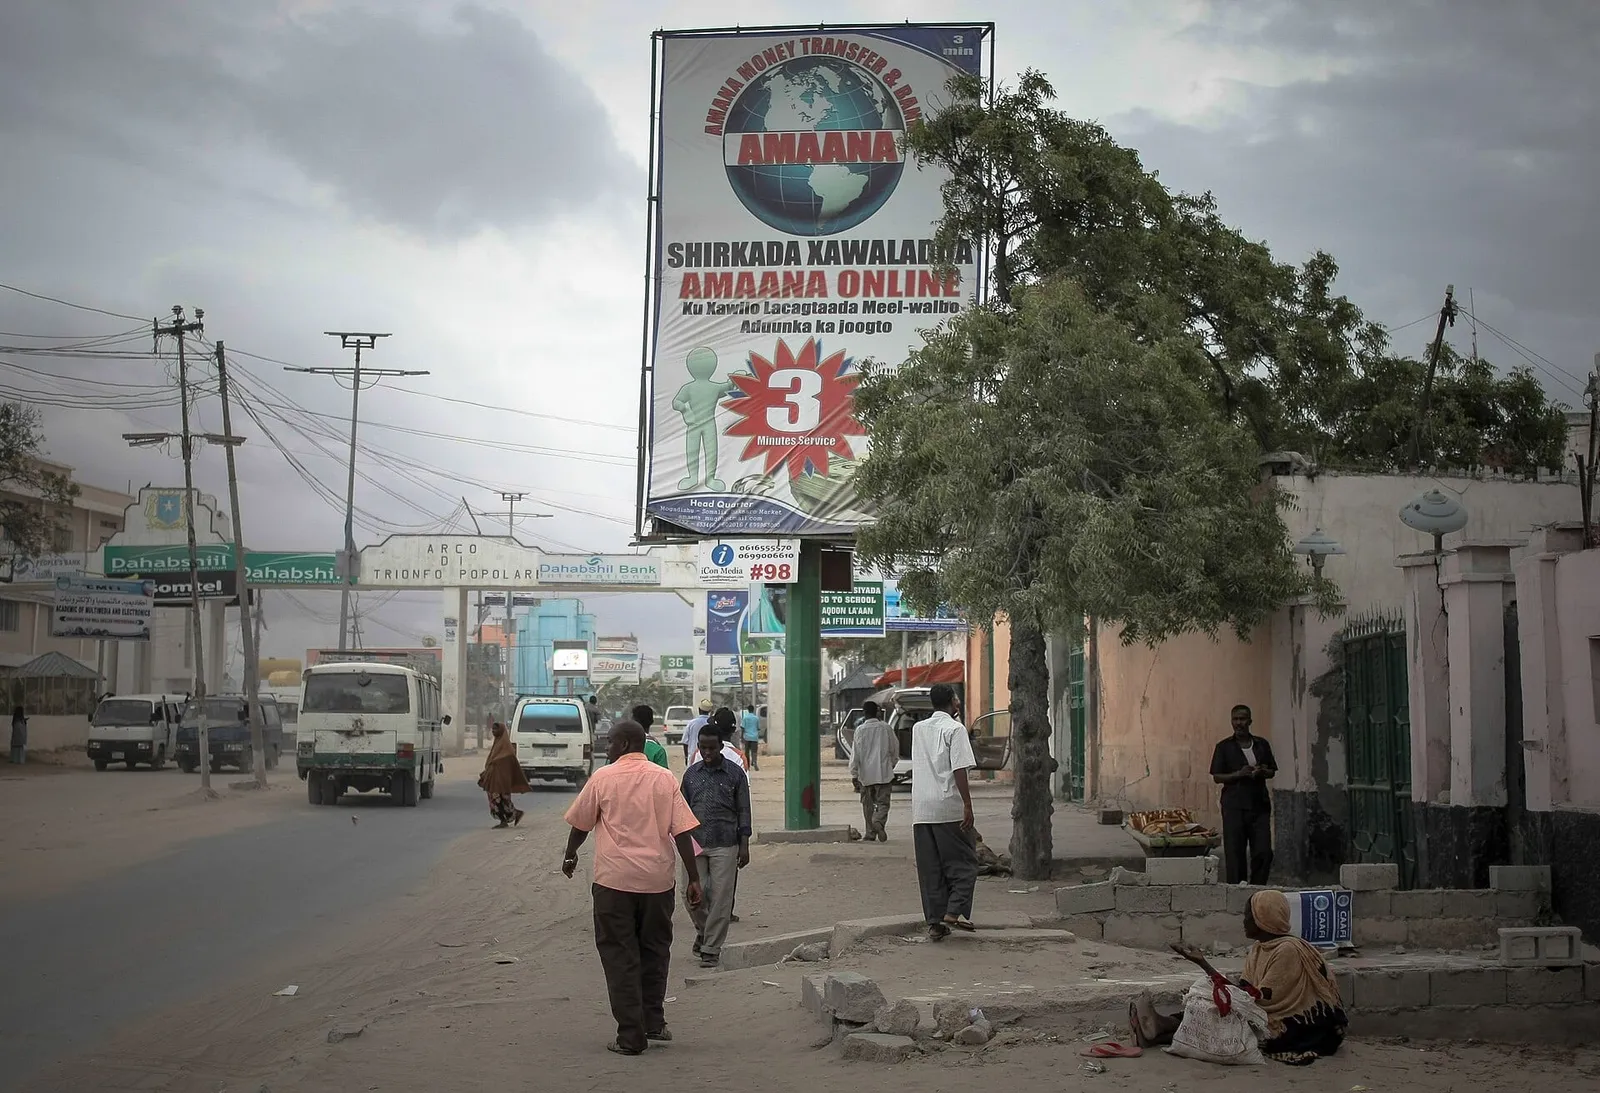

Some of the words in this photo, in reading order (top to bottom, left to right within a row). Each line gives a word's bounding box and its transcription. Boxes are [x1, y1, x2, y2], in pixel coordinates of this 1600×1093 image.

[952, 34, 964, 45] 3
[942, 46, 974, 56] min
[704, 77, 745, 137] AMANA
[736, 40, 795, 83] MONEY
[800, 36, 889, 75] TRANSFER
[882, 68, 902, 89] &
[893, 83, 923, 131] BAN
[737, 131, 898, 165] AMAANA
[667, 241, 802, 268] SHIRKADA
[678, 270, 829, 299] AMAANA
[837, 269, 960, 297] ONLINE
[682, 301, 704, 315] Ku
[763, 301, 859, 316] Lacagtaada
[861, 300, 960, 314] Meel-walbo
[740, 320, 813, 334] Aduunka
[815, 320, 836, 334] ka
[838, 320, 893, 334] joogto
[765, 368, 824, 433] 3
[756, 435, 797, 446] Minutes
[798, 435, 836, 447] Service
[689, 499, 714, 508] Head
[716, 499, 754, 510] Quarter
[427, 543, 477, 554] ARCO
[739, 544, 792, 552] 0616555570
[245, 566, 340, 580] ahabshi
[373, 569, 443, 580] TRIONFO
[539, 564, 614, 574] Dahabshil
[619, 565, 657, 574] Bank
[701, 566, 719, 575] iCon
[720, 567, 743, 575] Media
[750, 563, 791, 580] #98
[831, 596, 843, 604] TO
[844, 596, 877, 604] SCHOOL
[56, 605, 78, 613] ACADEMIC
[85, 606, 111, 615] MULTIMEDIA
[111, 608, 121, 616] AND
[121, 608, 151, 617] ELECTRONICS
[848, 606, 874, 615] LA'AAN
[832, 617, 854, 625] IFTIIN
[856, 617, 882, 626] LA'AAN
[668, 657, 684, 668] 3G
[1318, 911, 1326, 939] CAAFI
[1339, 910, 1347, 938] CAAFI
